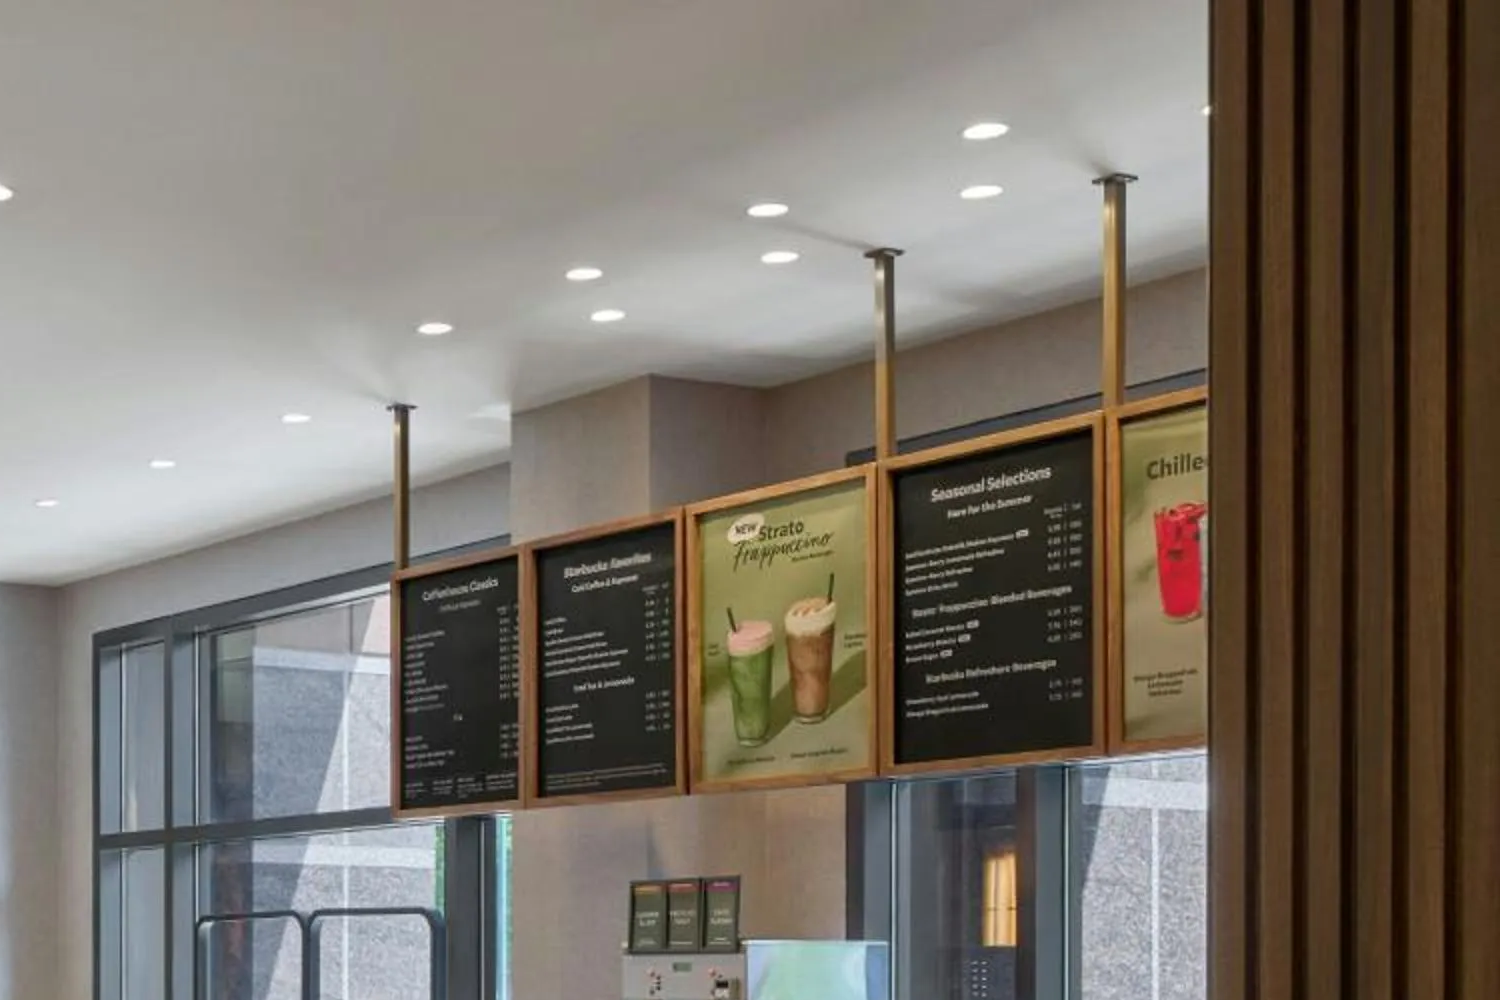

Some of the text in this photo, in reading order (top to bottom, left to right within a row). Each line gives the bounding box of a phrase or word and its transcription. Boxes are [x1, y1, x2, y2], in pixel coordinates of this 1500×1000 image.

[931, 467, 1051, 502] Seasonal Selections
[758, 521, 805, 541] Strato
